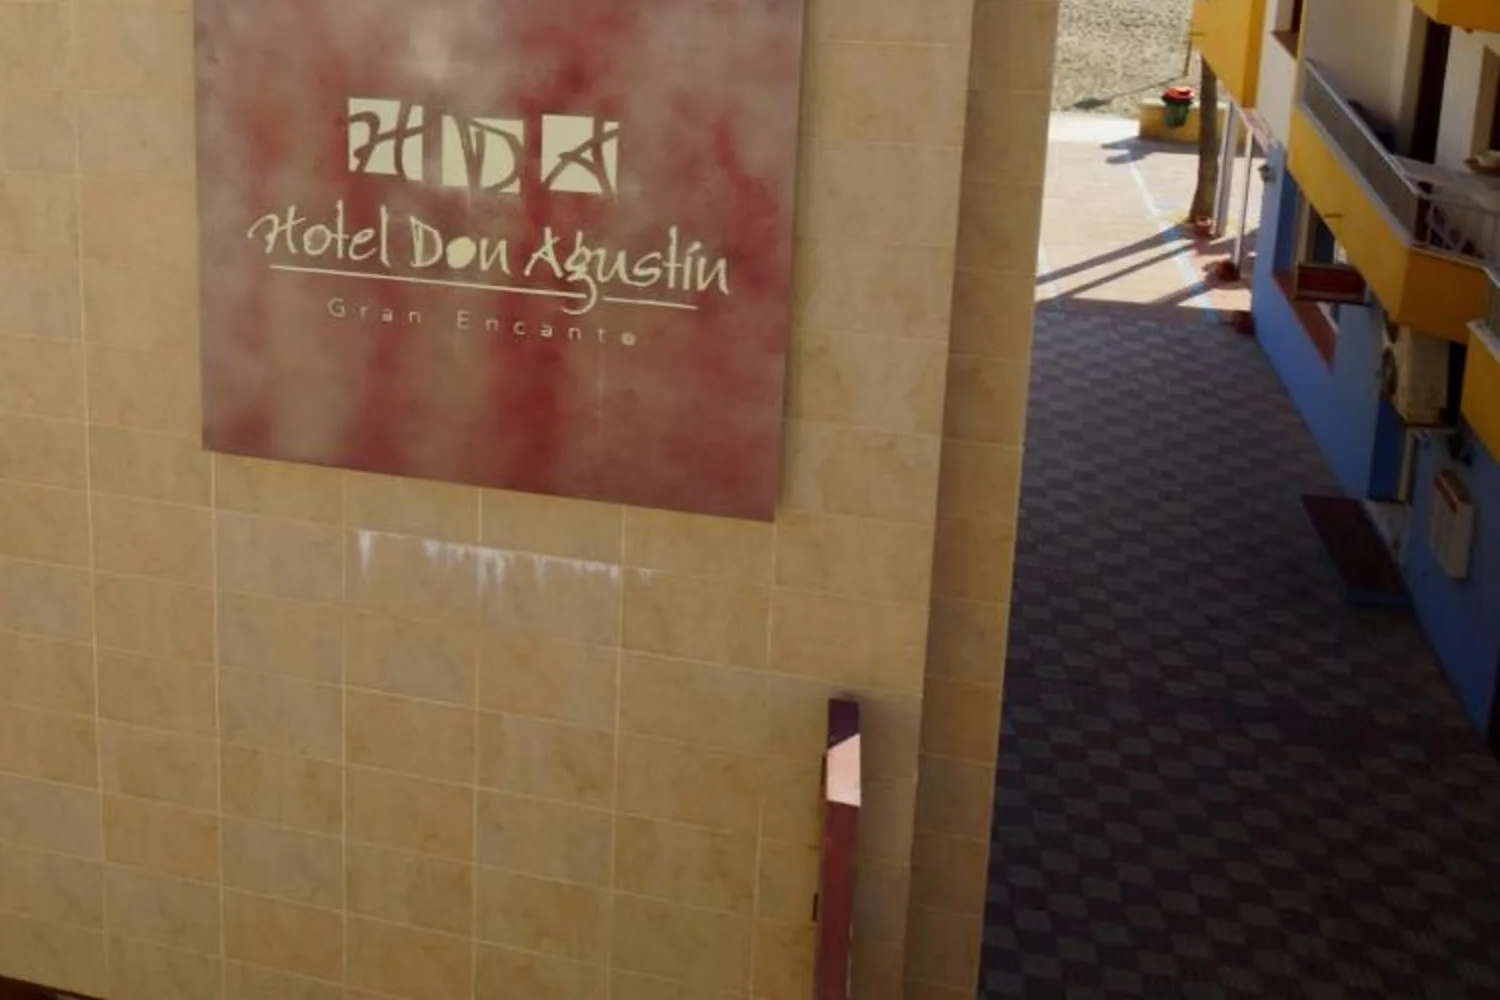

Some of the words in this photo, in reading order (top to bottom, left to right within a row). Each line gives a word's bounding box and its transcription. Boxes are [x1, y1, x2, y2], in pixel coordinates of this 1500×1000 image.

[247, 200, 390, 267] Hotel
[409, 216, 512, 275] Don
[328, 297, 422, 325] Gran
[456, 310, 637, 346] Encanto
